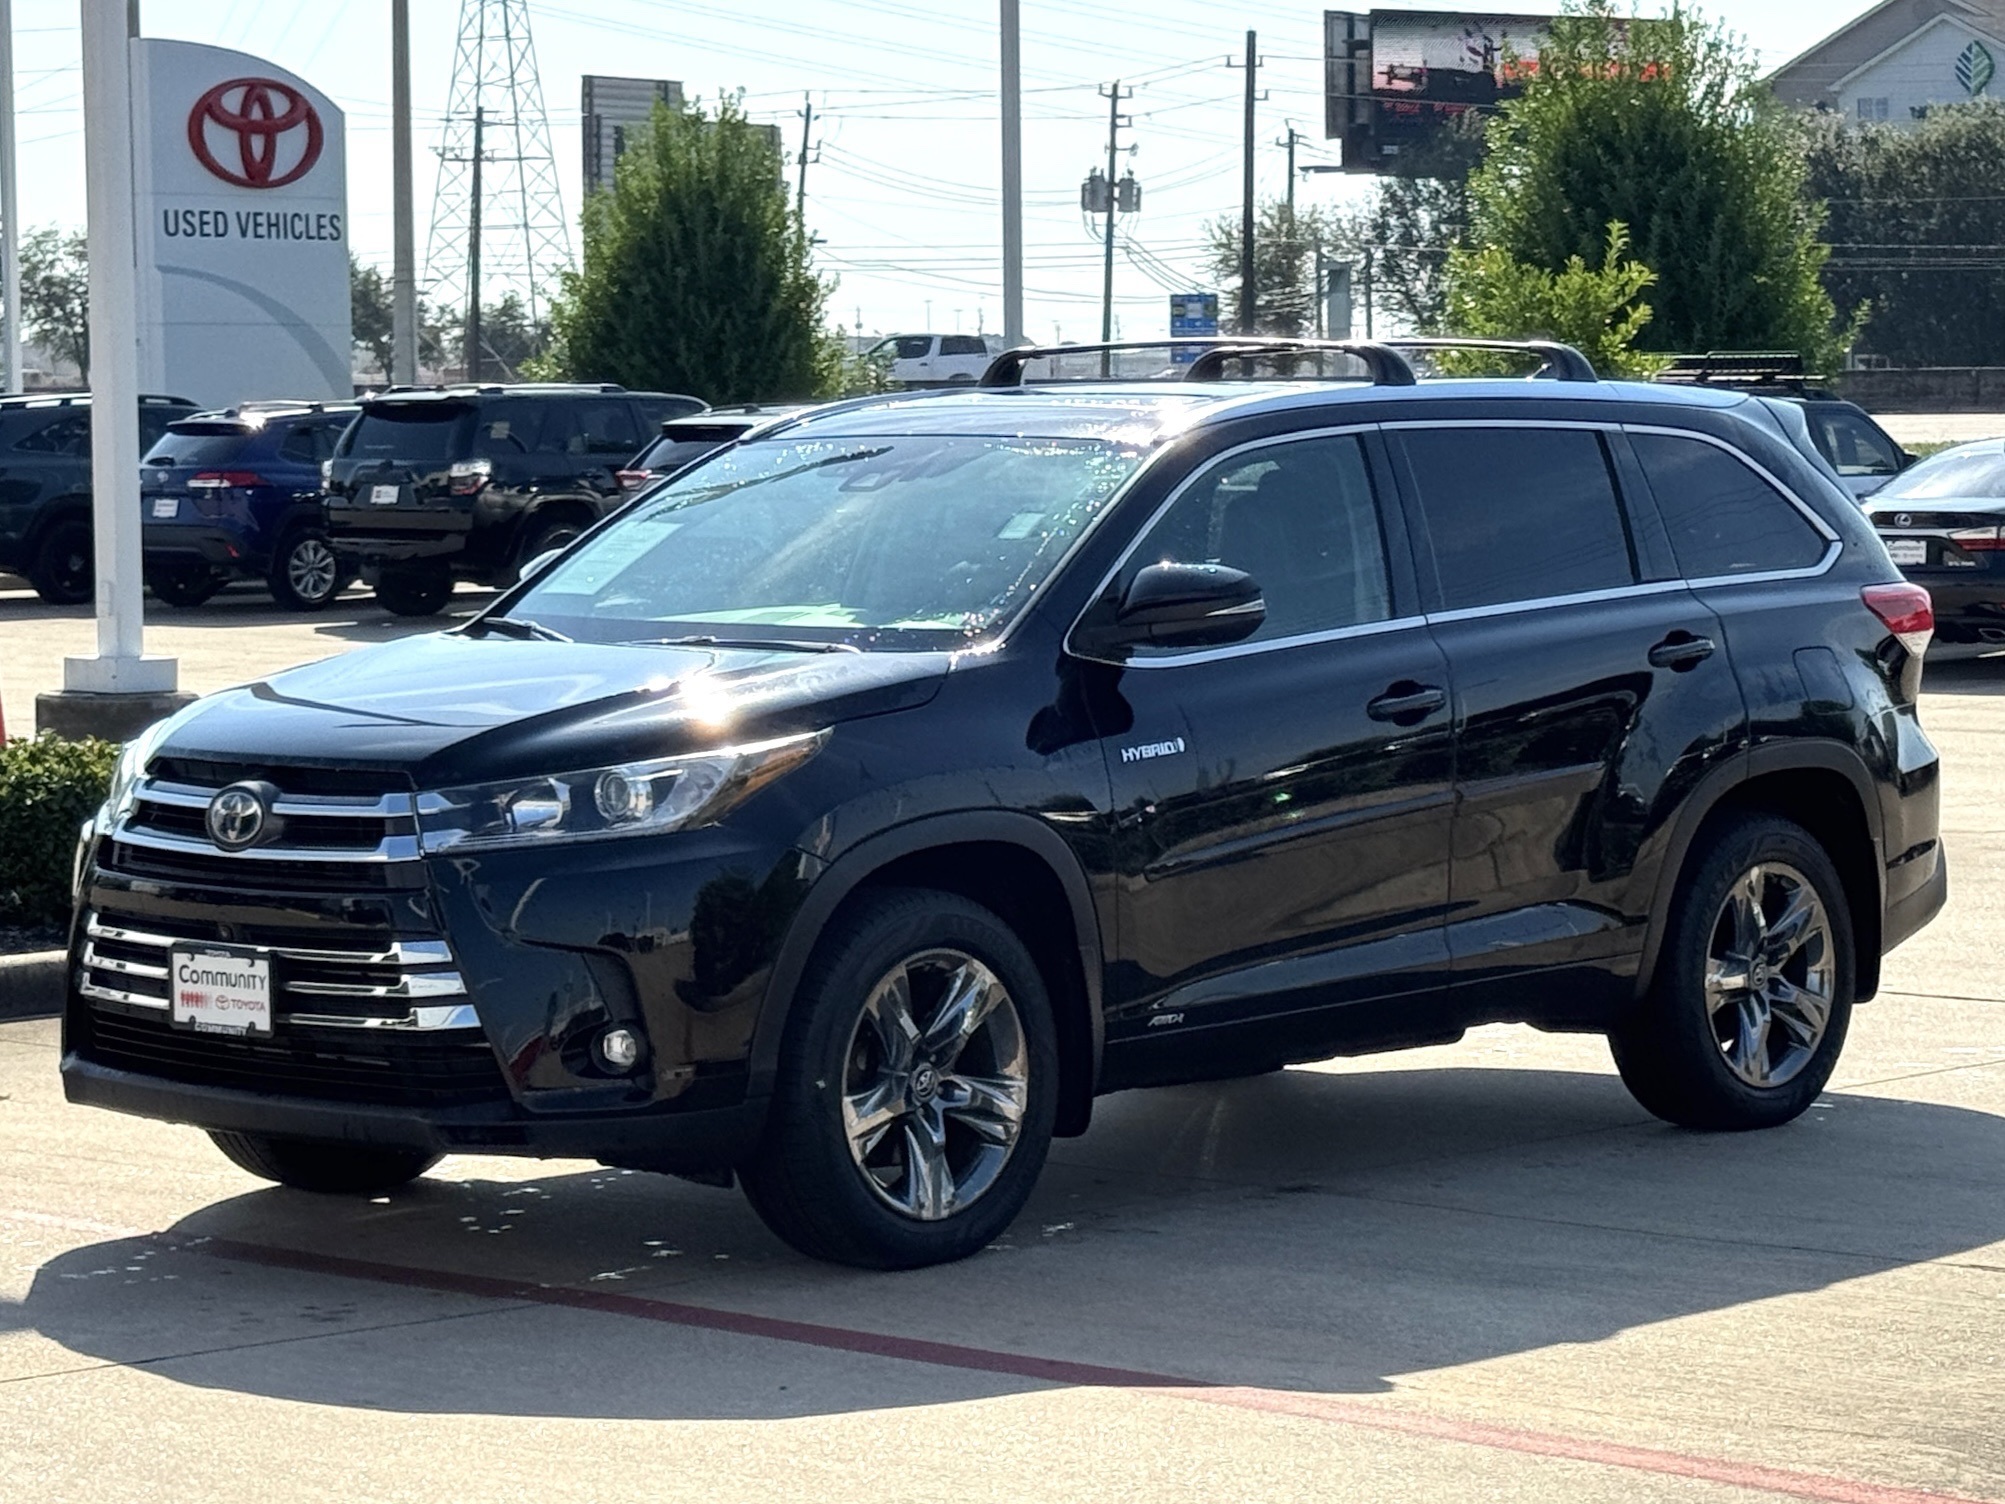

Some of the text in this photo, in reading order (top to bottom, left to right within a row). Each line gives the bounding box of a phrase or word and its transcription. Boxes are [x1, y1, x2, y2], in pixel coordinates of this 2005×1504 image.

[163, 208, 342, 241] USED VEHICLES
[1120, 740, 1178, 763] HYBRID
[231, 998, 266, 1012] TOYOTA
